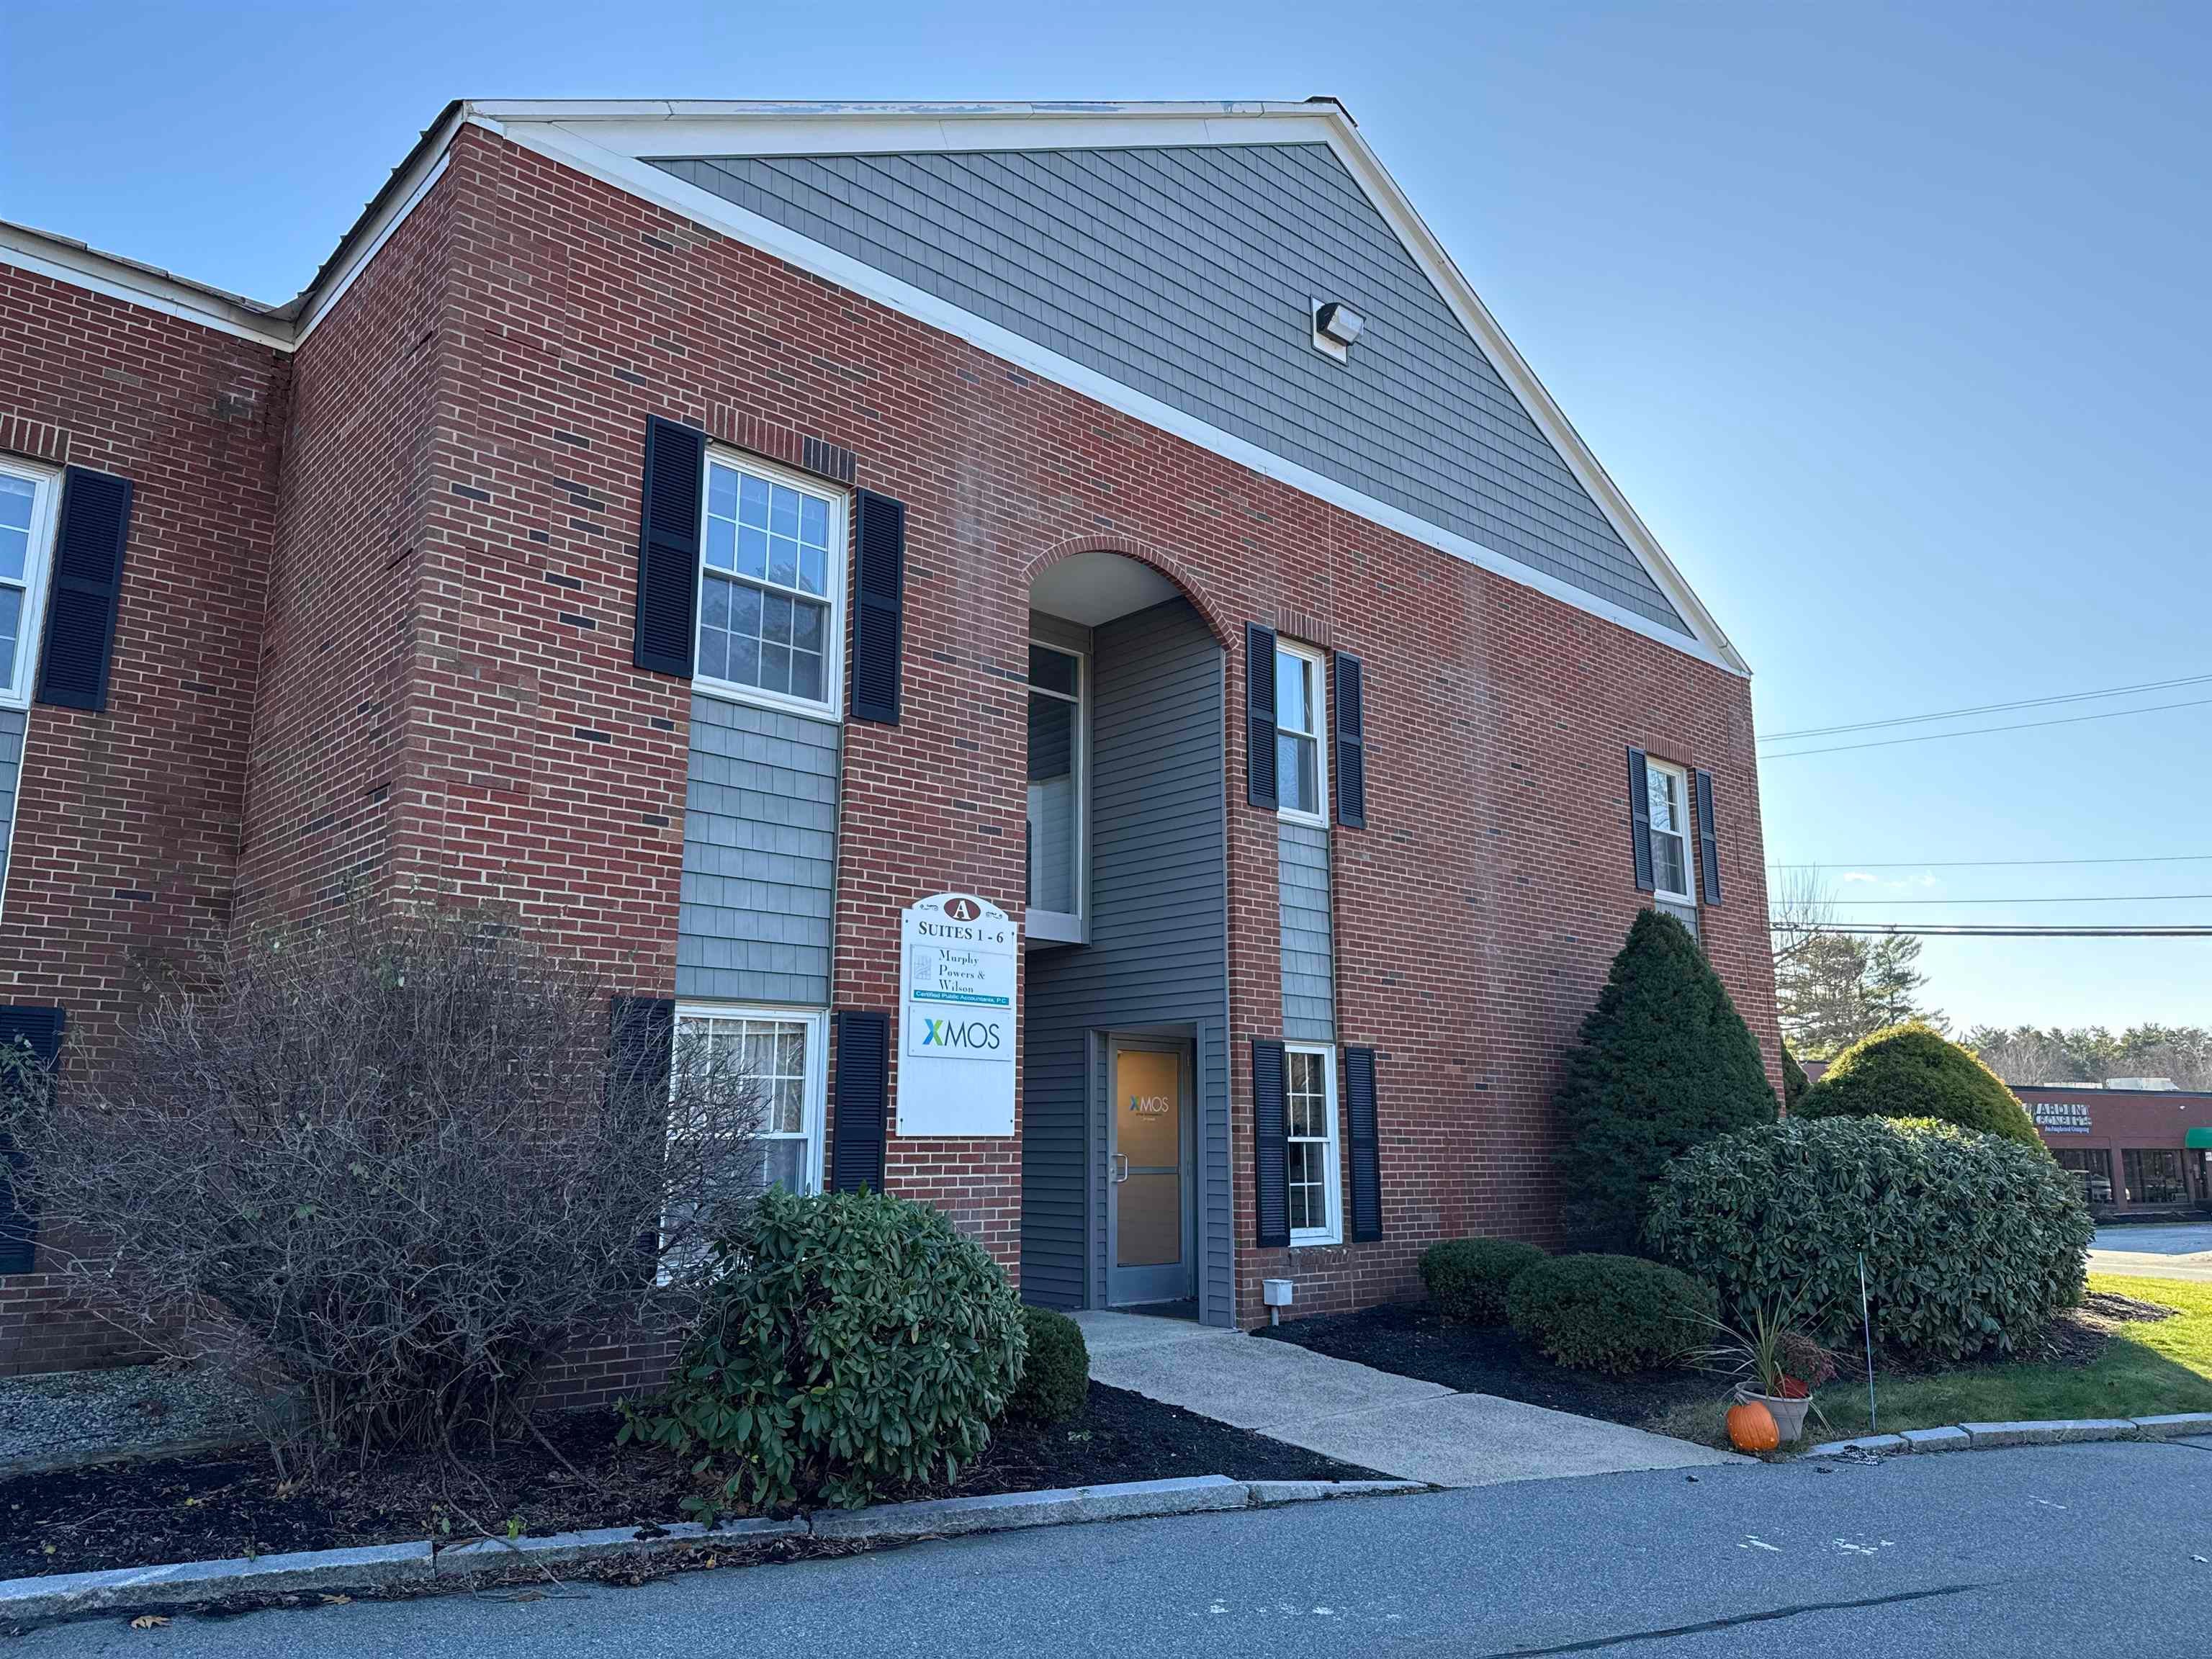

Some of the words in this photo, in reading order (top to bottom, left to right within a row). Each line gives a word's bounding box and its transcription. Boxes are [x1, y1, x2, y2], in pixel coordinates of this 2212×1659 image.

[953, 900, 971, 920] A
[919, 921, 972, 940] SUITES
[979, 930, 982, 941] 1
[997, 932, 1004, 943] 6
[939, 949, 979, 966] Murphy
[939, 964, 974, 979] Powers
[977, 971, 985, 980] &
[939, 979, 974, 993] Wilson
[922, 1018, 1000, 1049] XMOS
[1129, 1095, 1169, 1112] XMOS
